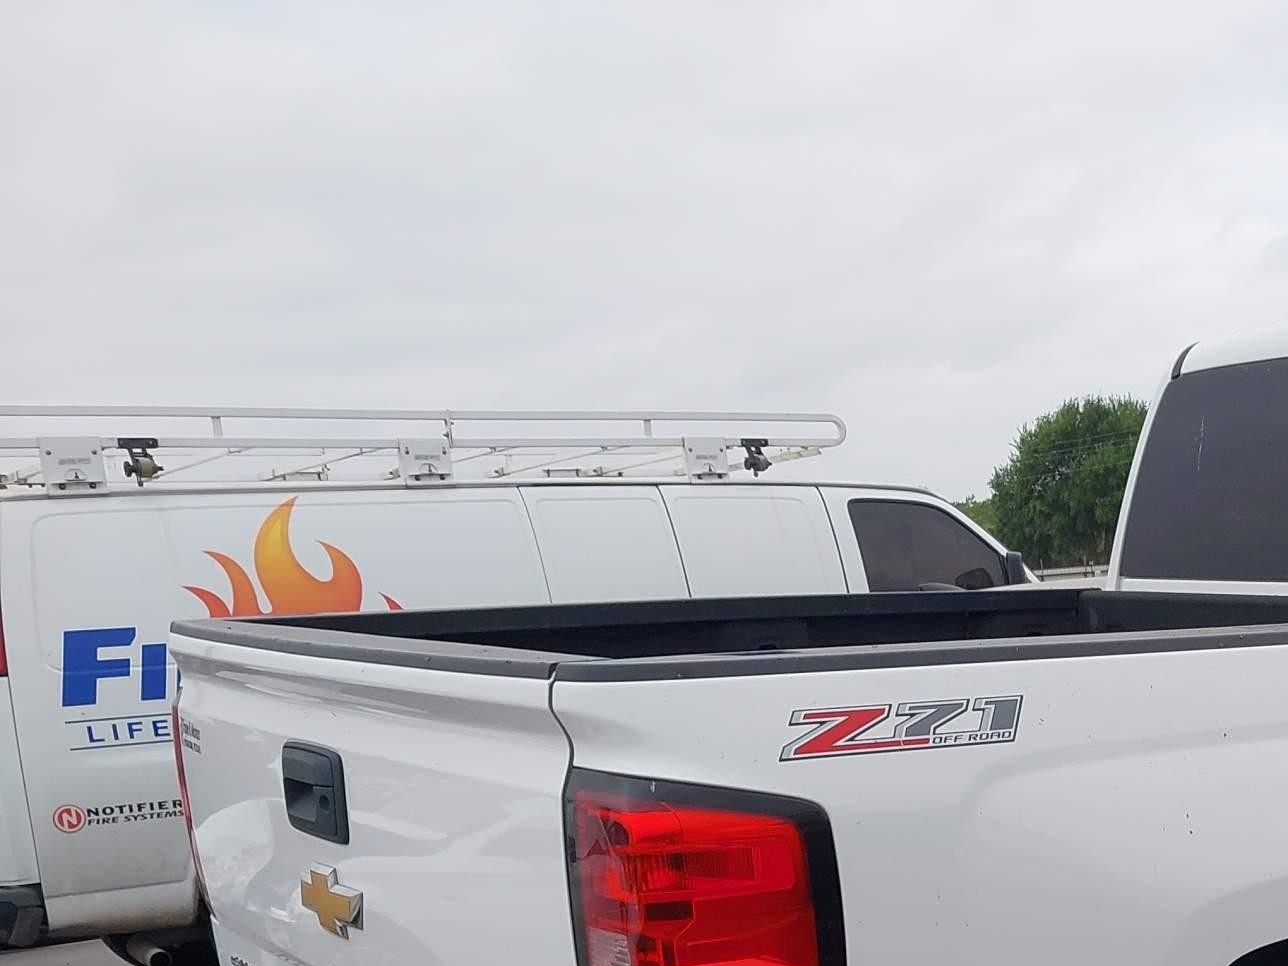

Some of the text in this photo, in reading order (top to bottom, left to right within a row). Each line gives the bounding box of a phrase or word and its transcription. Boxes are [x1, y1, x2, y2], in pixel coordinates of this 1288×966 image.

[86, 719, 171, 743] LIFE
[779, 695, 1023, 762] Z71
[932, 730, 1012, 745] OFF ROAD
[86, 799, 183, 817] NOTIFIER
[87, 810, 184, 826] FIRE SYSTEMS
